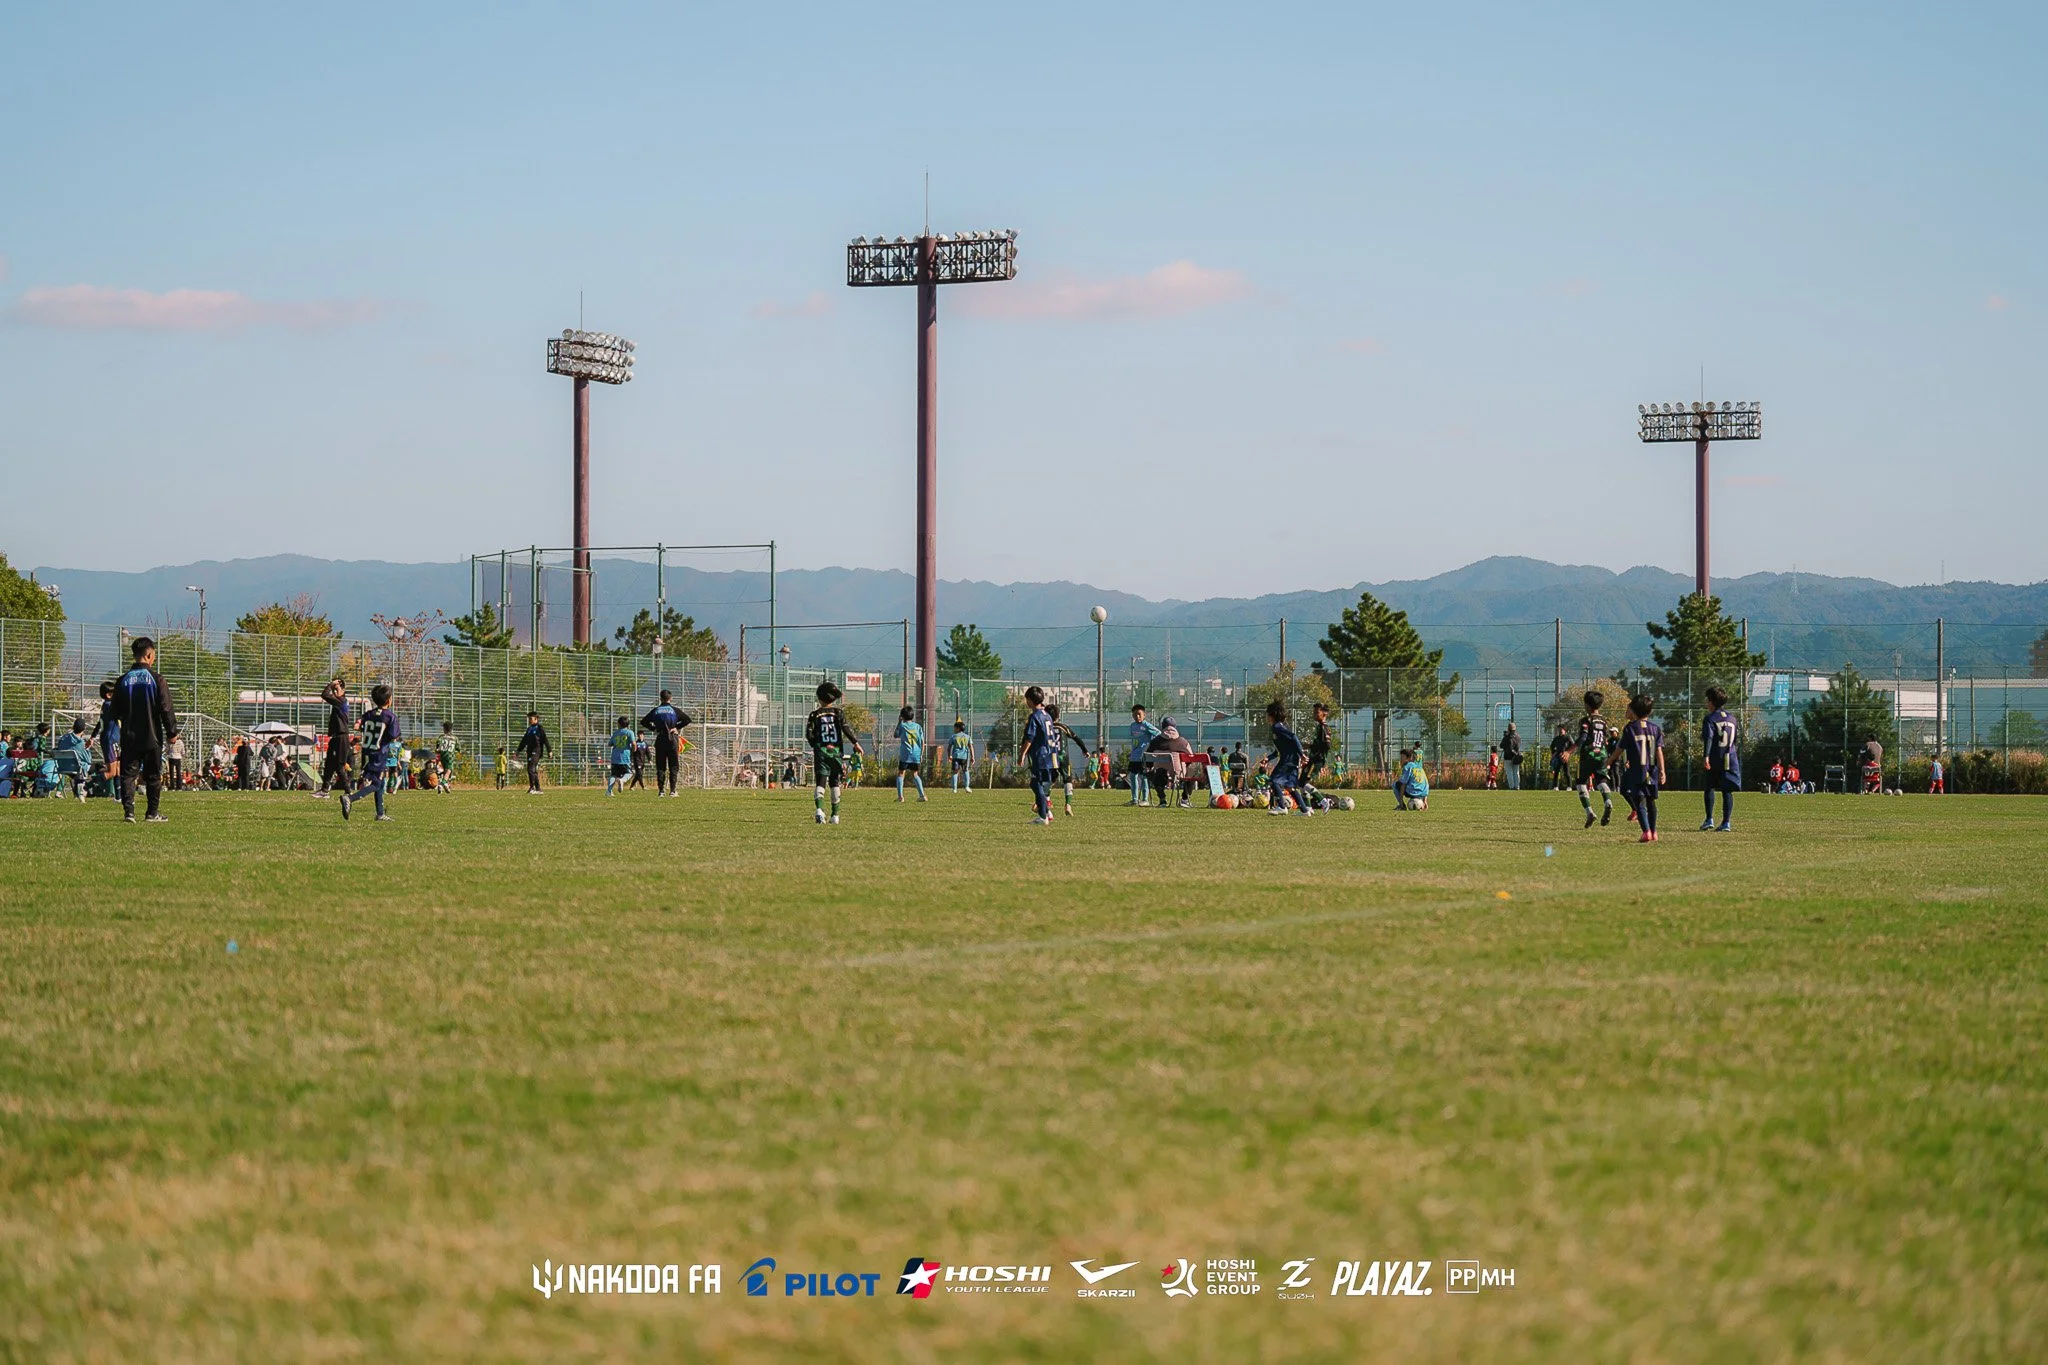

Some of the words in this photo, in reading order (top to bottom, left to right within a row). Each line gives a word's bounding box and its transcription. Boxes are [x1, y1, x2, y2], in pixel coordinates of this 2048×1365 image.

[362, 720, 386, 750] 63
[821, 724, 838, 743] 23
[1715, 721, 1736, 748] 57
[1770, 767, 1781, 778] 63
